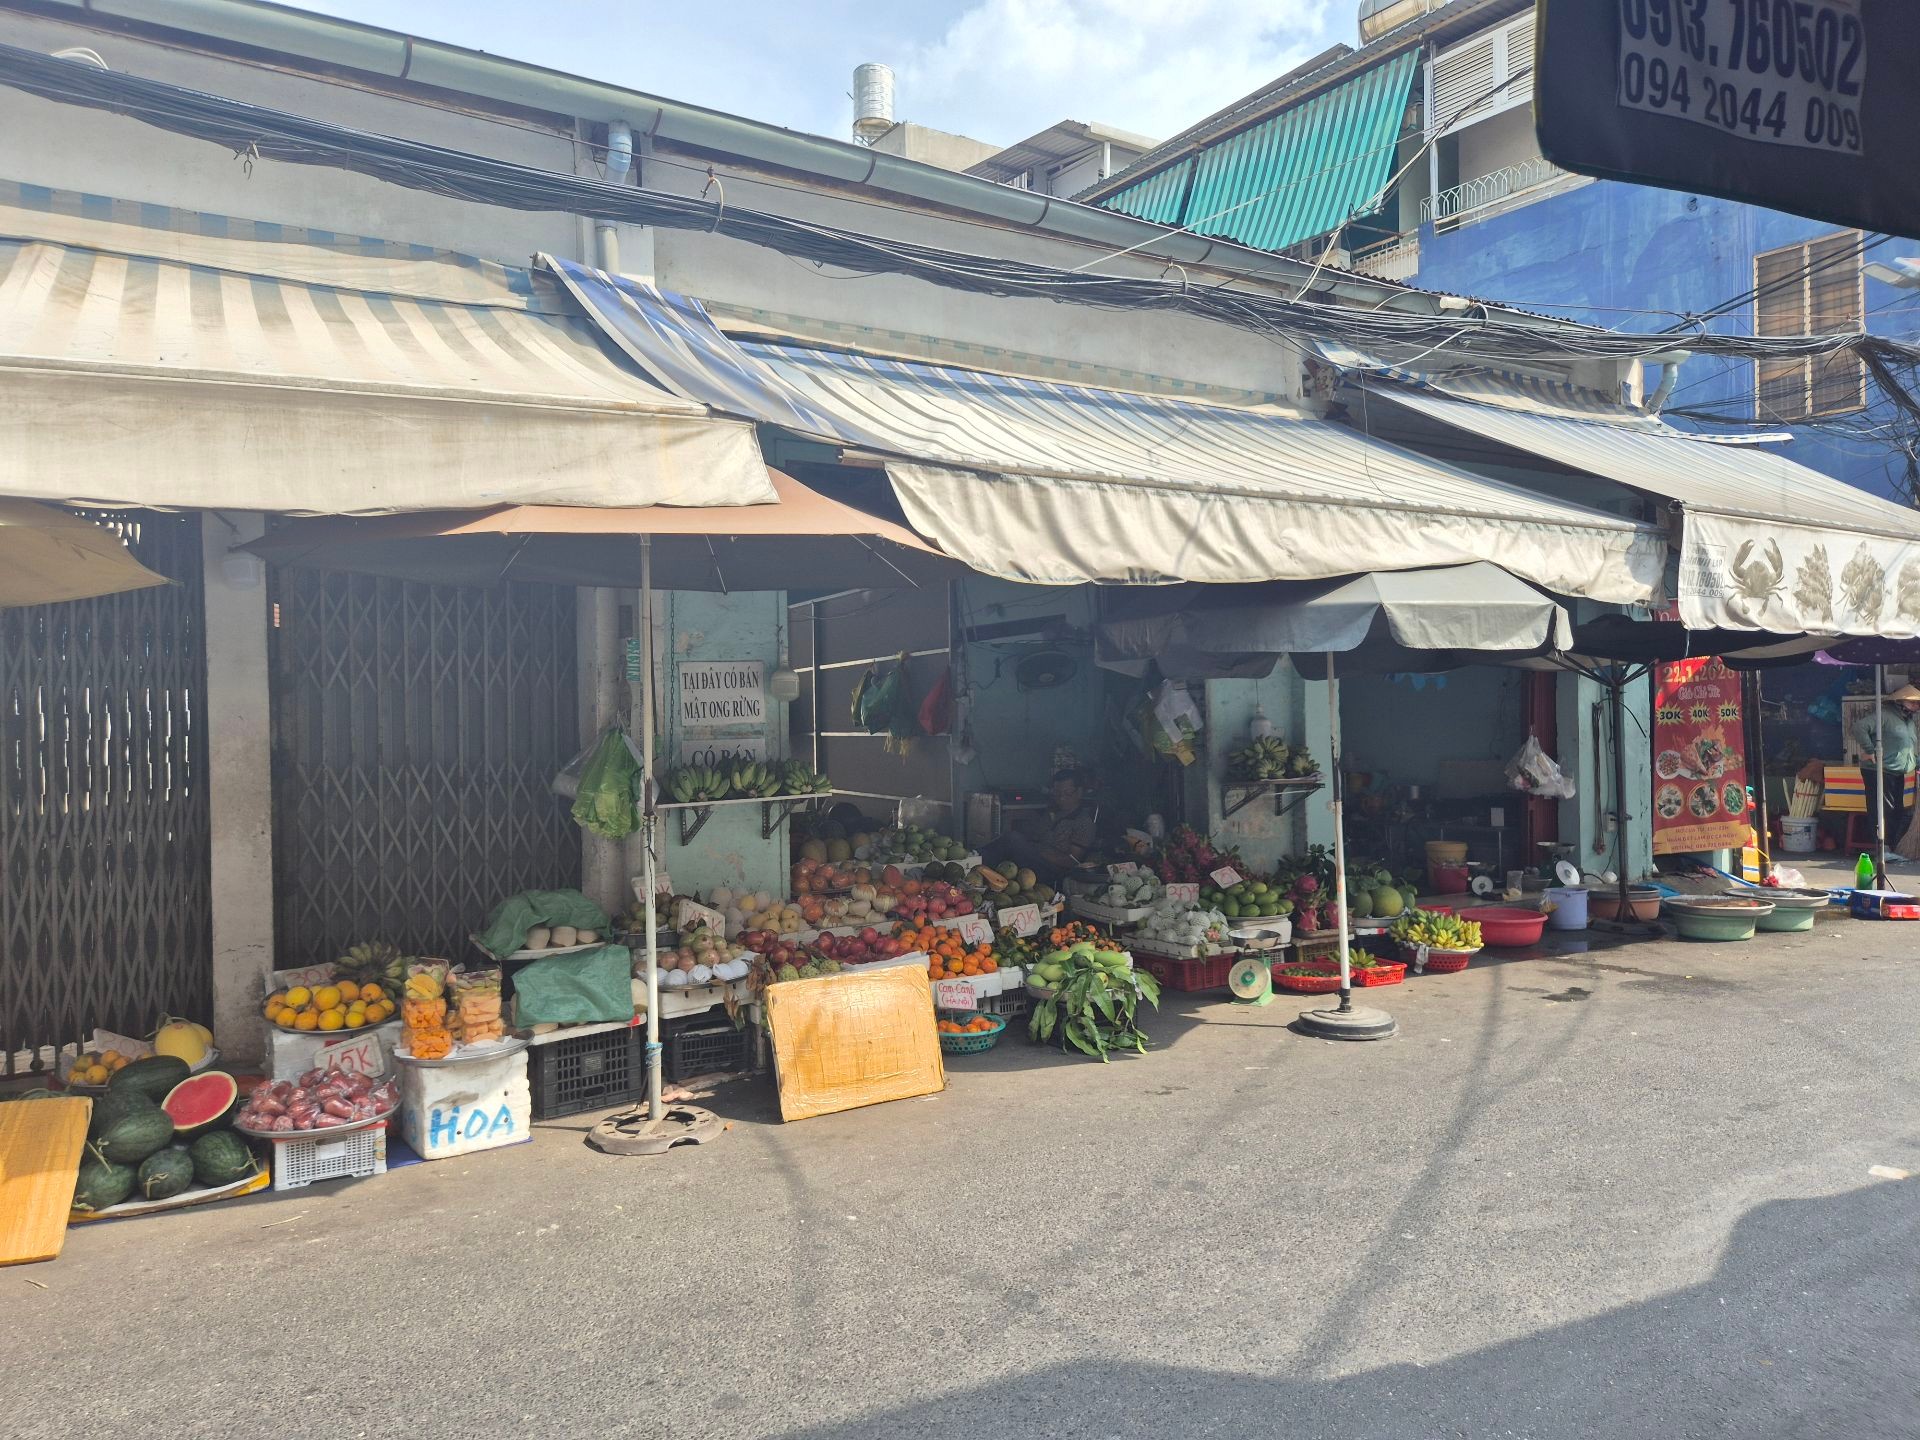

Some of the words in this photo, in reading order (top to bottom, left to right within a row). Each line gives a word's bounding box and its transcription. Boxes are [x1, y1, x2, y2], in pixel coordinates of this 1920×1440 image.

[1624, 52, 1691, 113] 094
[1703, 76, 1787, 138] 2044
[1804, 96, 1860, 151] 009
[682, 671, 700, 693] TẠI
[702, 666, 722, 690] ĐÂY
[724, 666, 738, 689] CÓ
[739, 665, 759, 688] BÁN
[684, 696, 707, 722] MẬT
[710, 700, 730, 718] ONG
[732, 695, 760, 717] RỪNG
[1660, 710, 1681, 720] 30K
[1692, 709, 1709, 718] 40K
[1721, 708, 1737, 717] 50K
[691, 744, 716, 768] CÓ
[720, 744, 756, 763] BN
